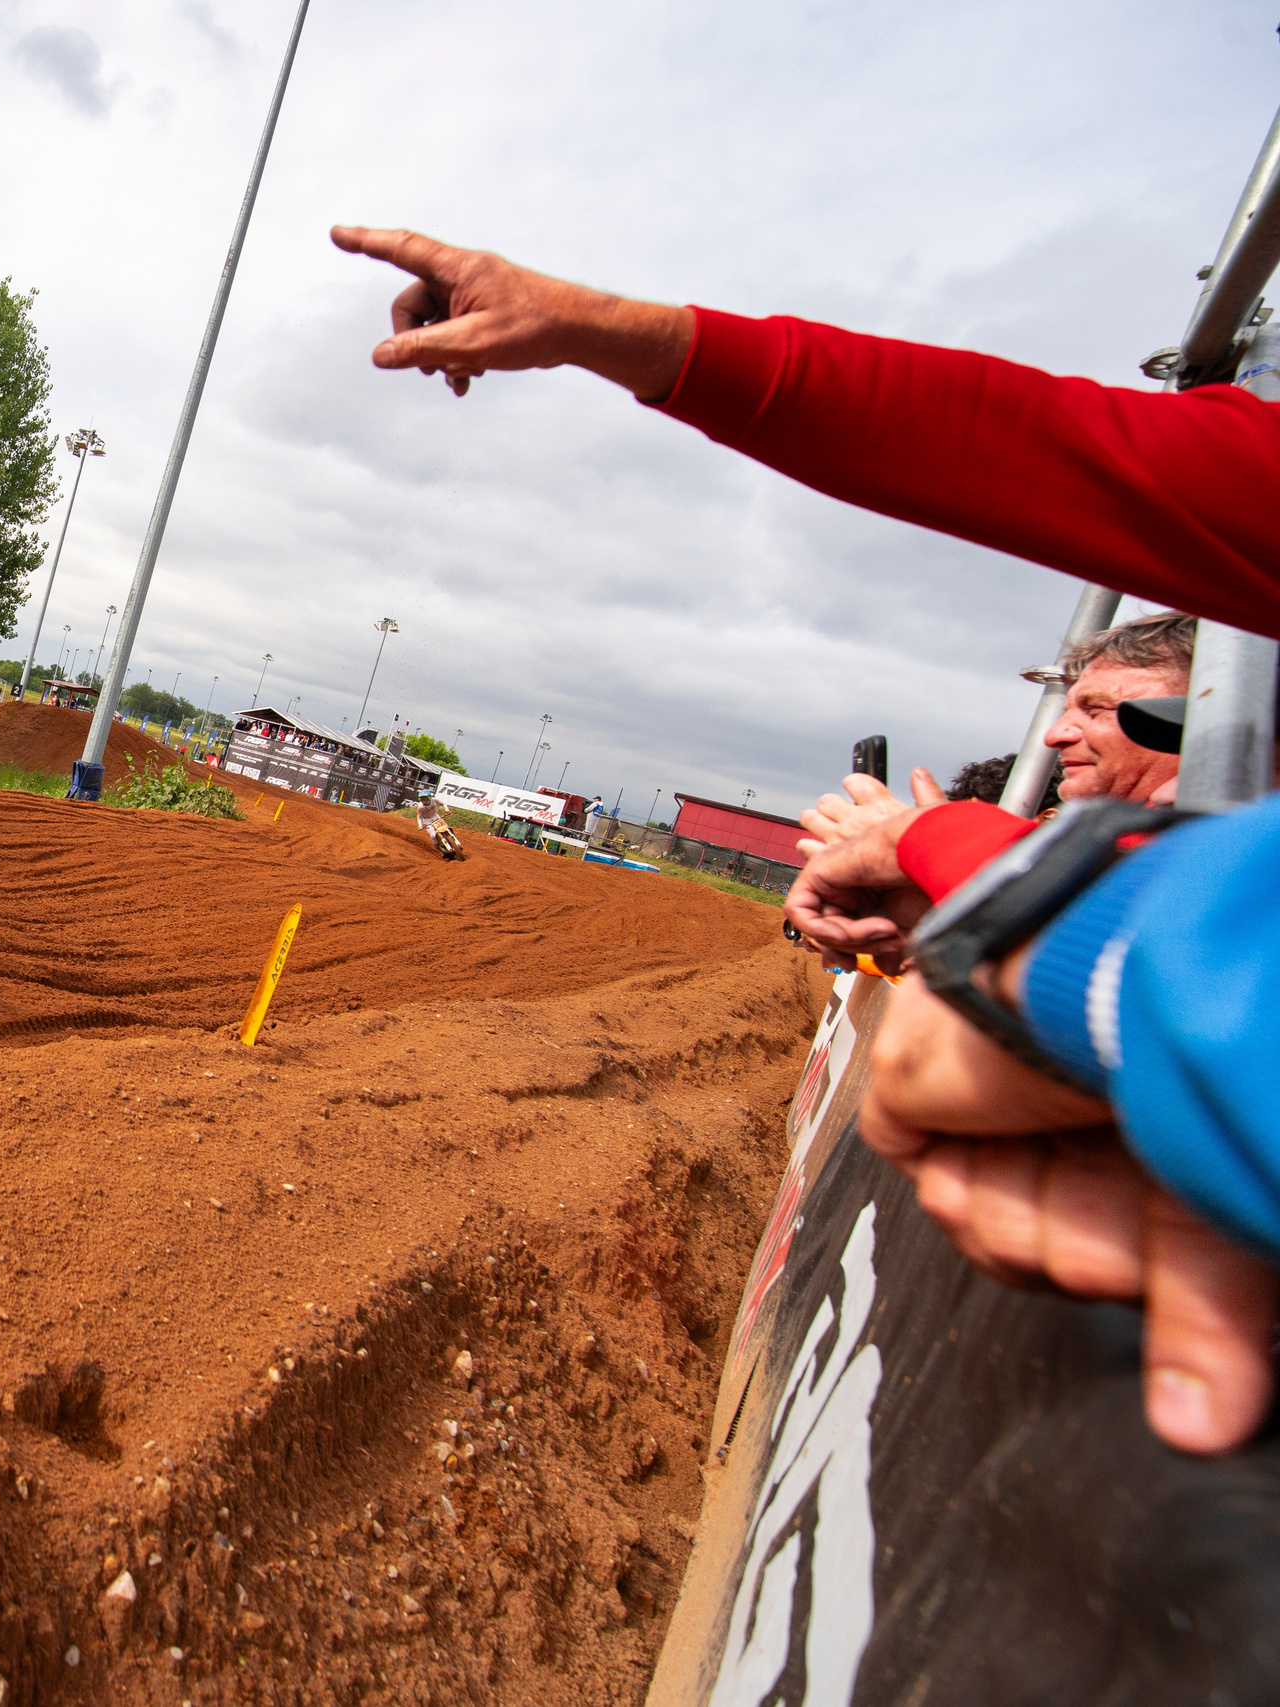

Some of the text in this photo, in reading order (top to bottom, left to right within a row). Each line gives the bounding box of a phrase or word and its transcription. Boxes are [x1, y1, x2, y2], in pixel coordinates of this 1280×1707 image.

[14, 686, 20, 695] 2
[438, 783, 495, 808] RGP MX
[498, 794, 558, 822] RGP MX
